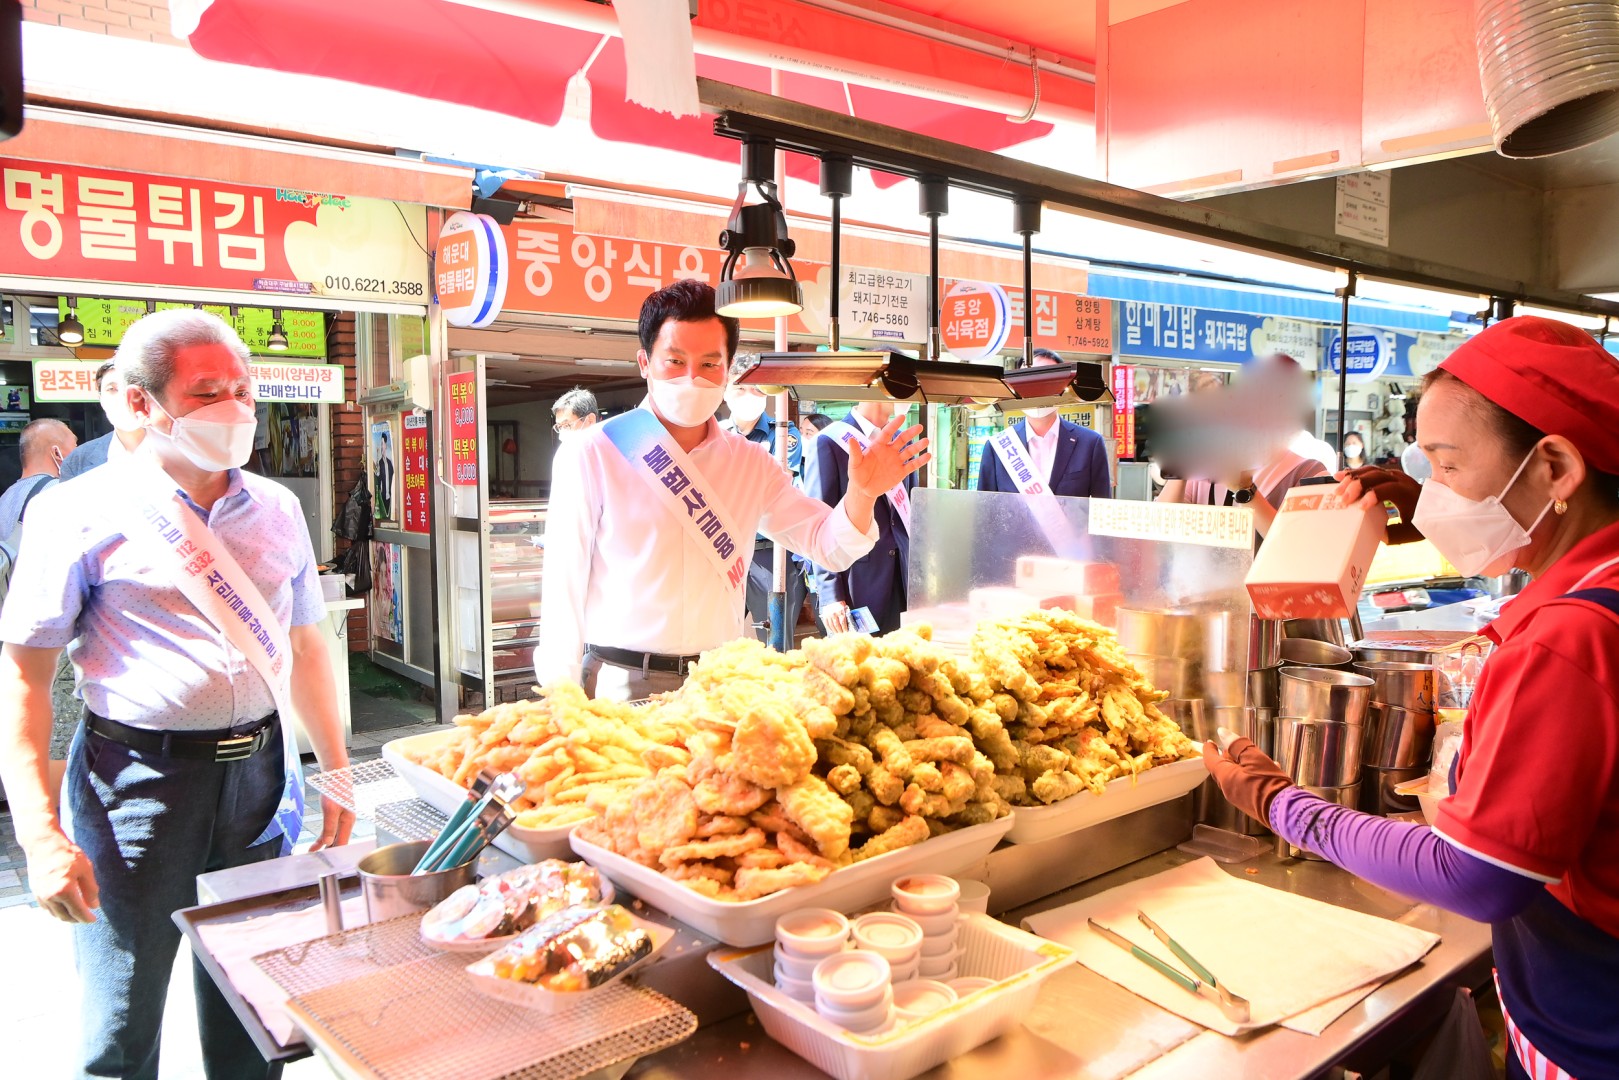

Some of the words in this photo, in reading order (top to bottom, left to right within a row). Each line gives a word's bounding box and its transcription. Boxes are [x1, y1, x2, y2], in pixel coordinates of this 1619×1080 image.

[3, 167, 267, 272] 명물튀김
[443, 241, 469, 265] 해운대
[325, 275, 423, 296] 010.6221.3588
[438, 267, 475, 295] 명물튀김
[848, 271, 913, 291] 최고급한우고기
[853, 291, 909, 309] 돼지고기전문
[953, 298, 982, 317] 중앙
[852, 311, 909, 326] T.746-5860
[946, 318, 990, 340] 식육점
[1075, 317, 1101, 331] 삼계탕
[1067, 336, 1109, 348] T.746-5922
[258, 384, 322, 399] 판매합니다
[642, 443, 735, 560] 불법사금융
[175, 539, 198, 560] 112
[184, 550, 215, 577] 1332
[206, 568, 278, 659] 서민금융상담은
